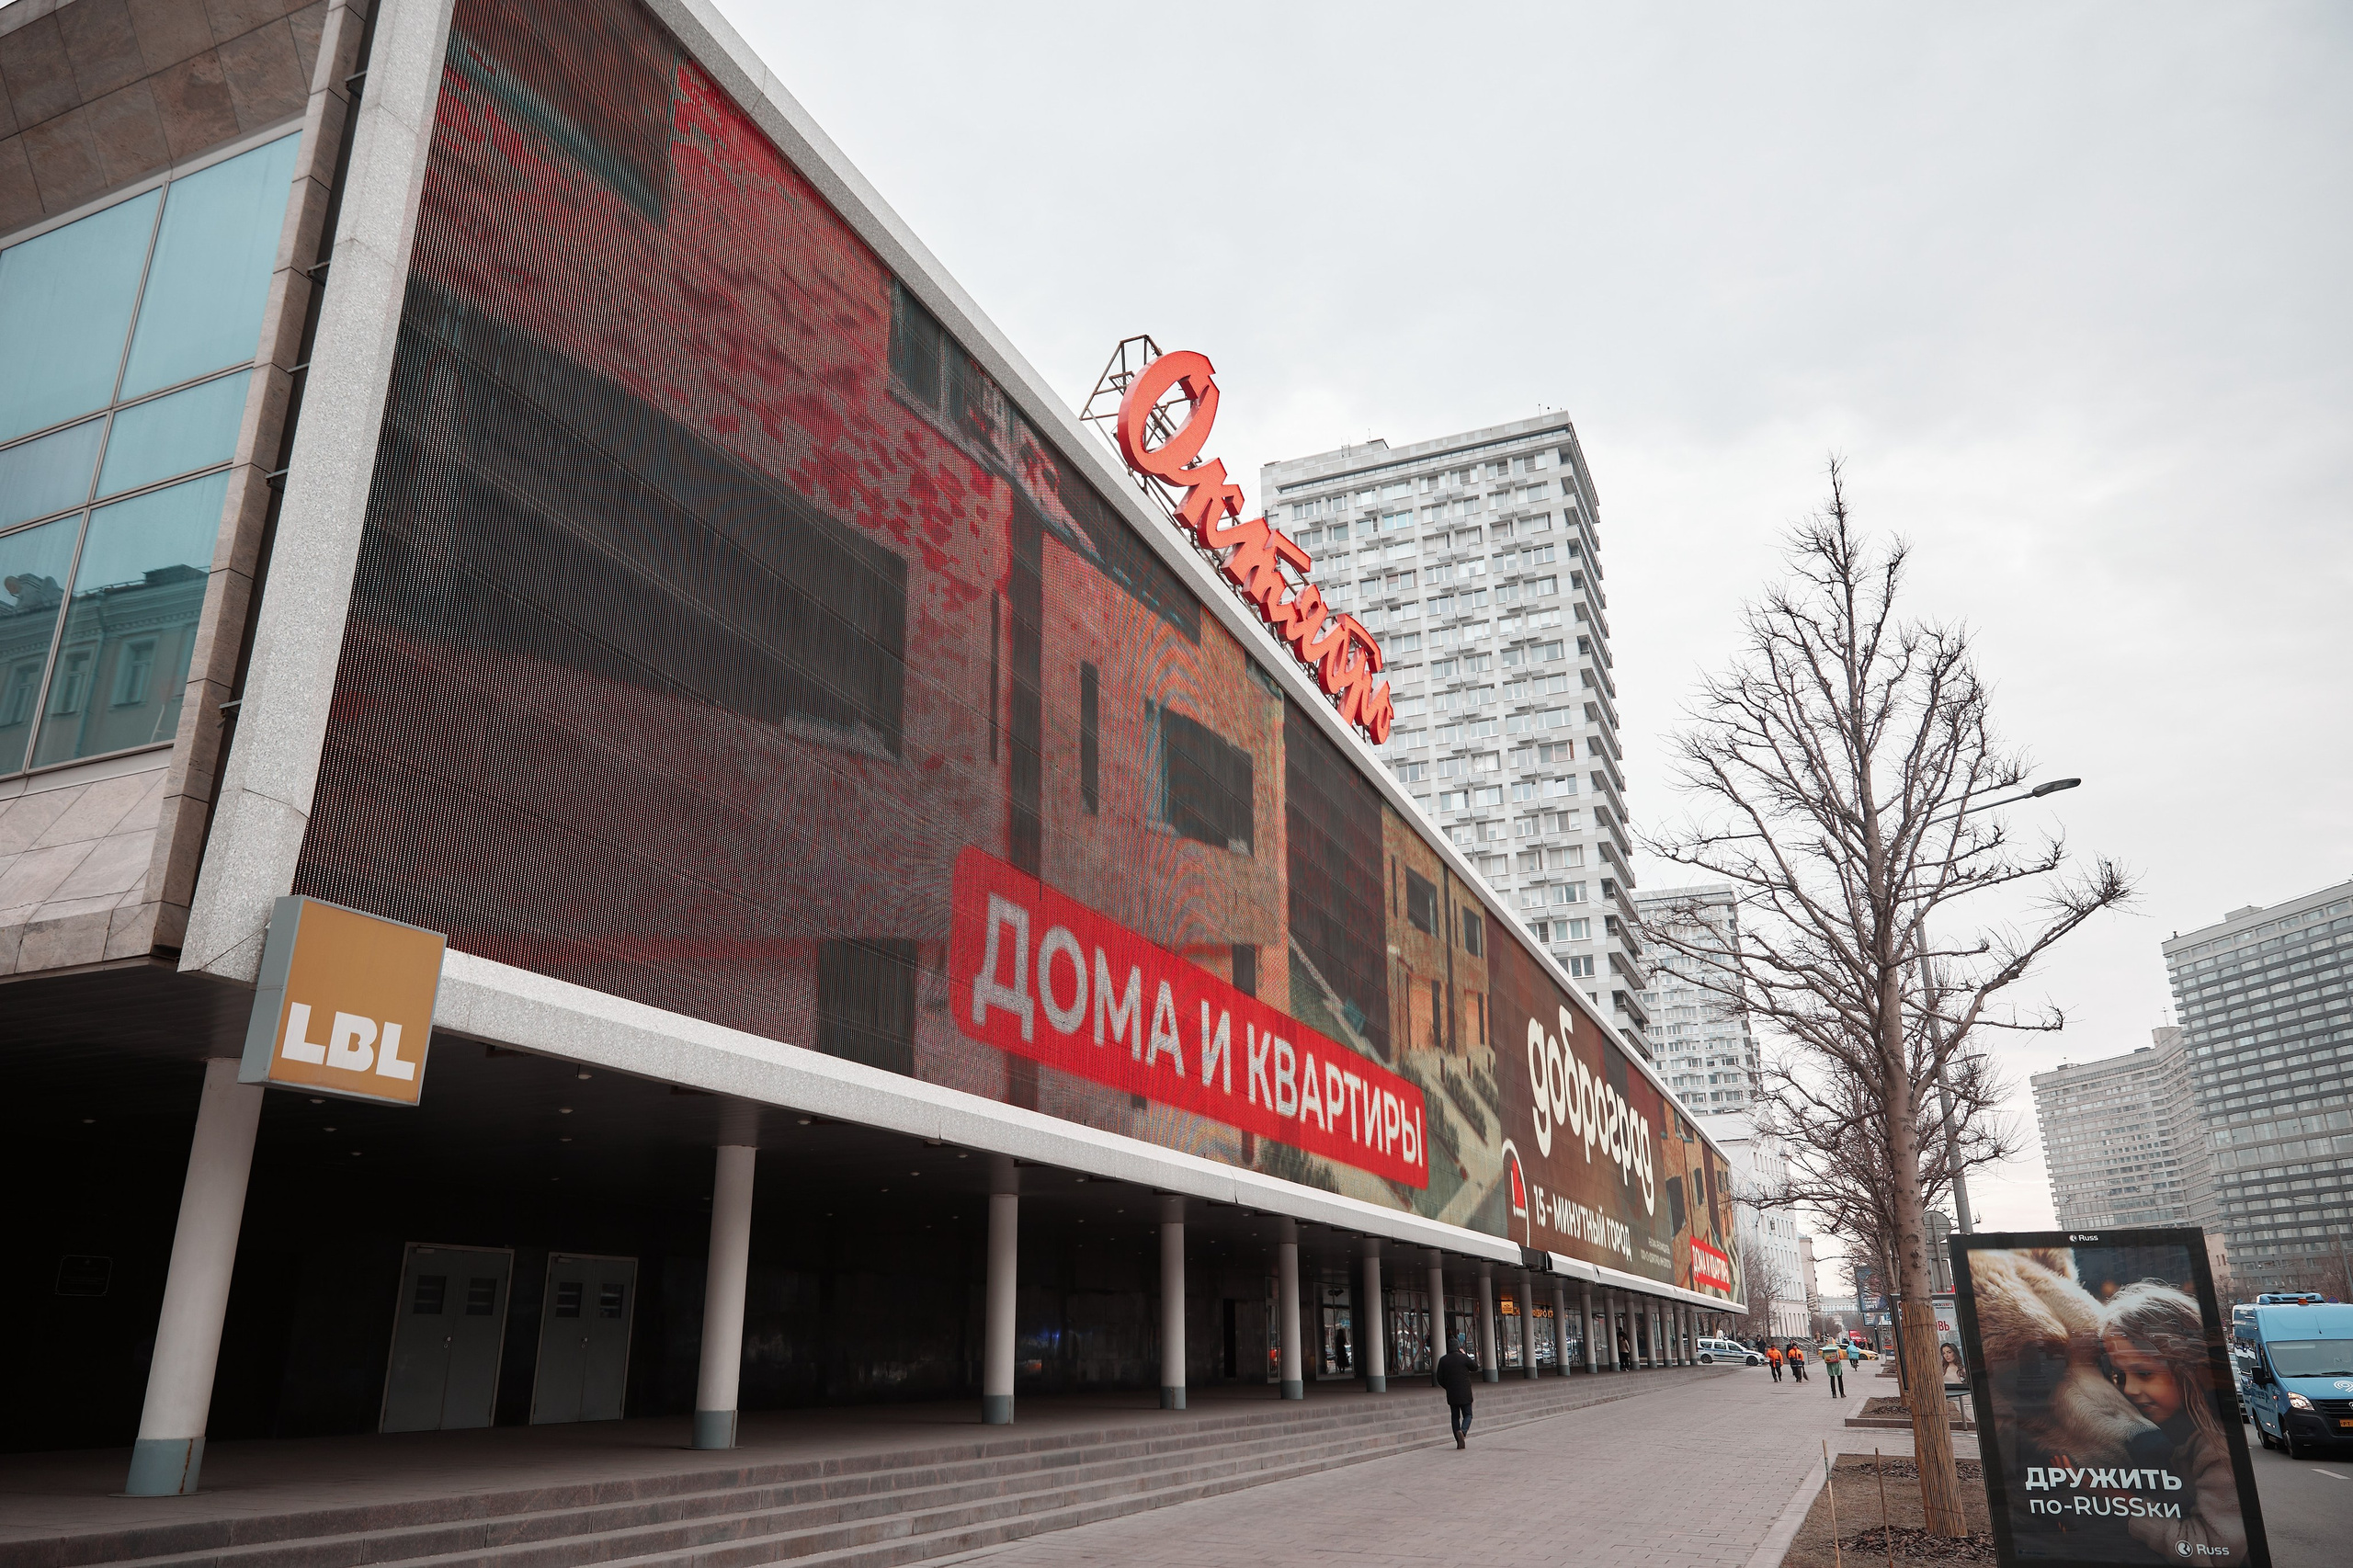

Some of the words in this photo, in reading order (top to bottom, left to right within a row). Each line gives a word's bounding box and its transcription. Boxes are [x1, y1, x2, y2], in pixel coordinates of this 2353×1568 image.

[280, 1001, 416, 1082] LBL
[972, 892, 1185, 1078] ДОМА
[1200, 999, 1232, 1096] И
[1246, 1021, 1424, 1168] КВАРТИРЫ
[1527, 1005, 1654, 1217] доброград
[1606, 1217, 1632, 1262] ГОРОД
[2025, 1467, 2183, 1492] ДРУЖИТЬ
[2029, 1495, 2182, 1518] по-RUSSки
[2196, 1543, 2231, 1556] Russ
